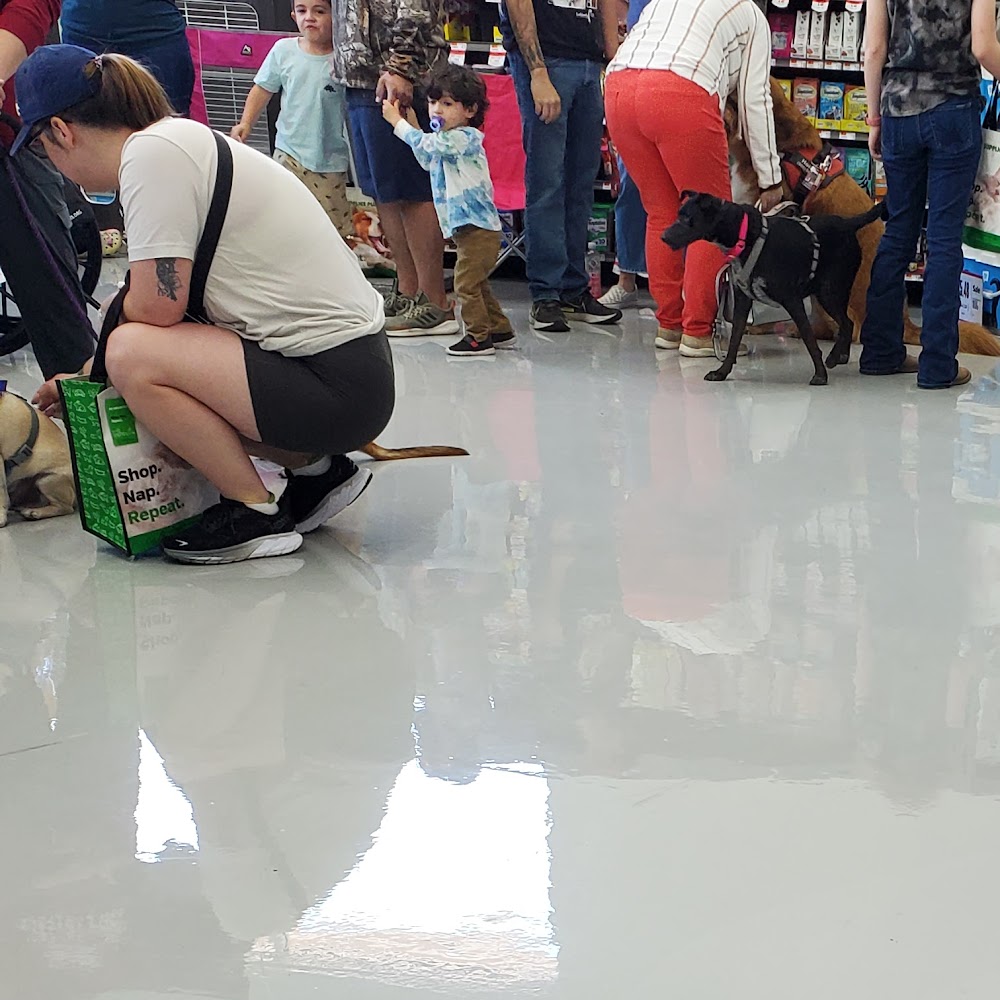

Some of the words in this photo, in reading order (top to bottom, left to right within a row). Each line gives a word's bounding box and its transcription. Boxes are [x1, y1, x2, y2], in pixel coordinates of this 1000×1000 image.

[118, 464, 162, 484] Shop.
[123, 487, 160, 504] Nap.
[127, 497, 185, 525] Repeat.
